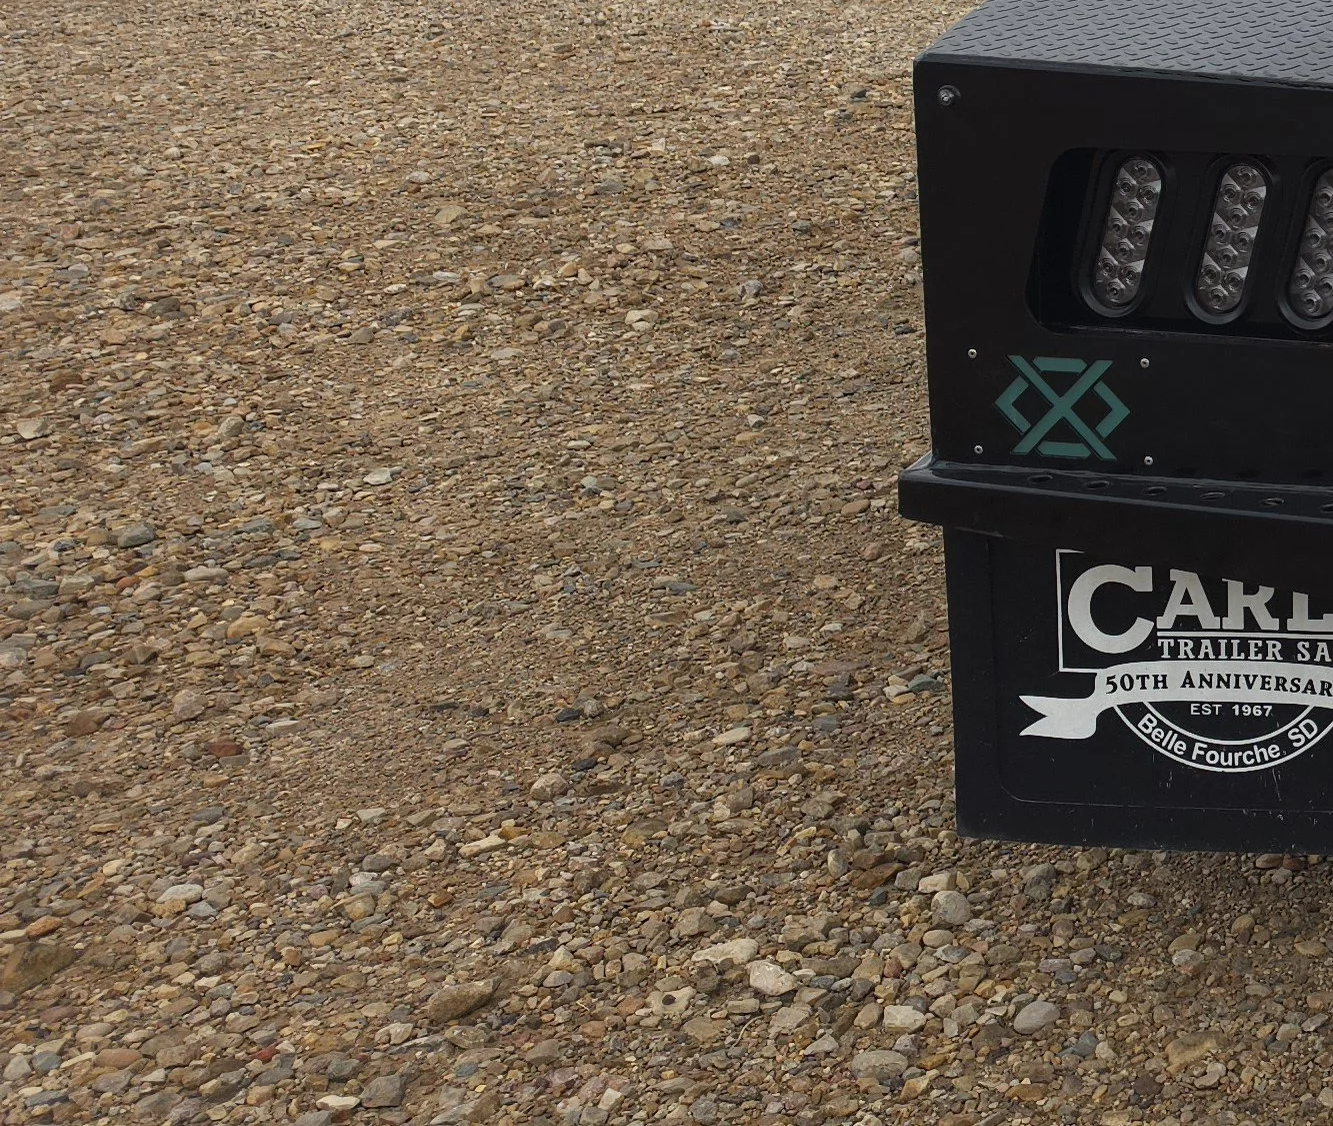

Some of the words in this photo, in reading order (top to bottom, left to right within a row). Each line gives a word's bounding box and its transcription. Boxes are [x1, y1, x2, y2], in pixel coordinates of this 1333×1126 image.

[1157, 638, 1283, 661] TRAILER
[1105, 674, 1169, 694] 50TH
[1231, 704, 1273, 717] 1967
[1137, 712, 1187, 756] Belle
[1287, 718, 1319, 749] SD
